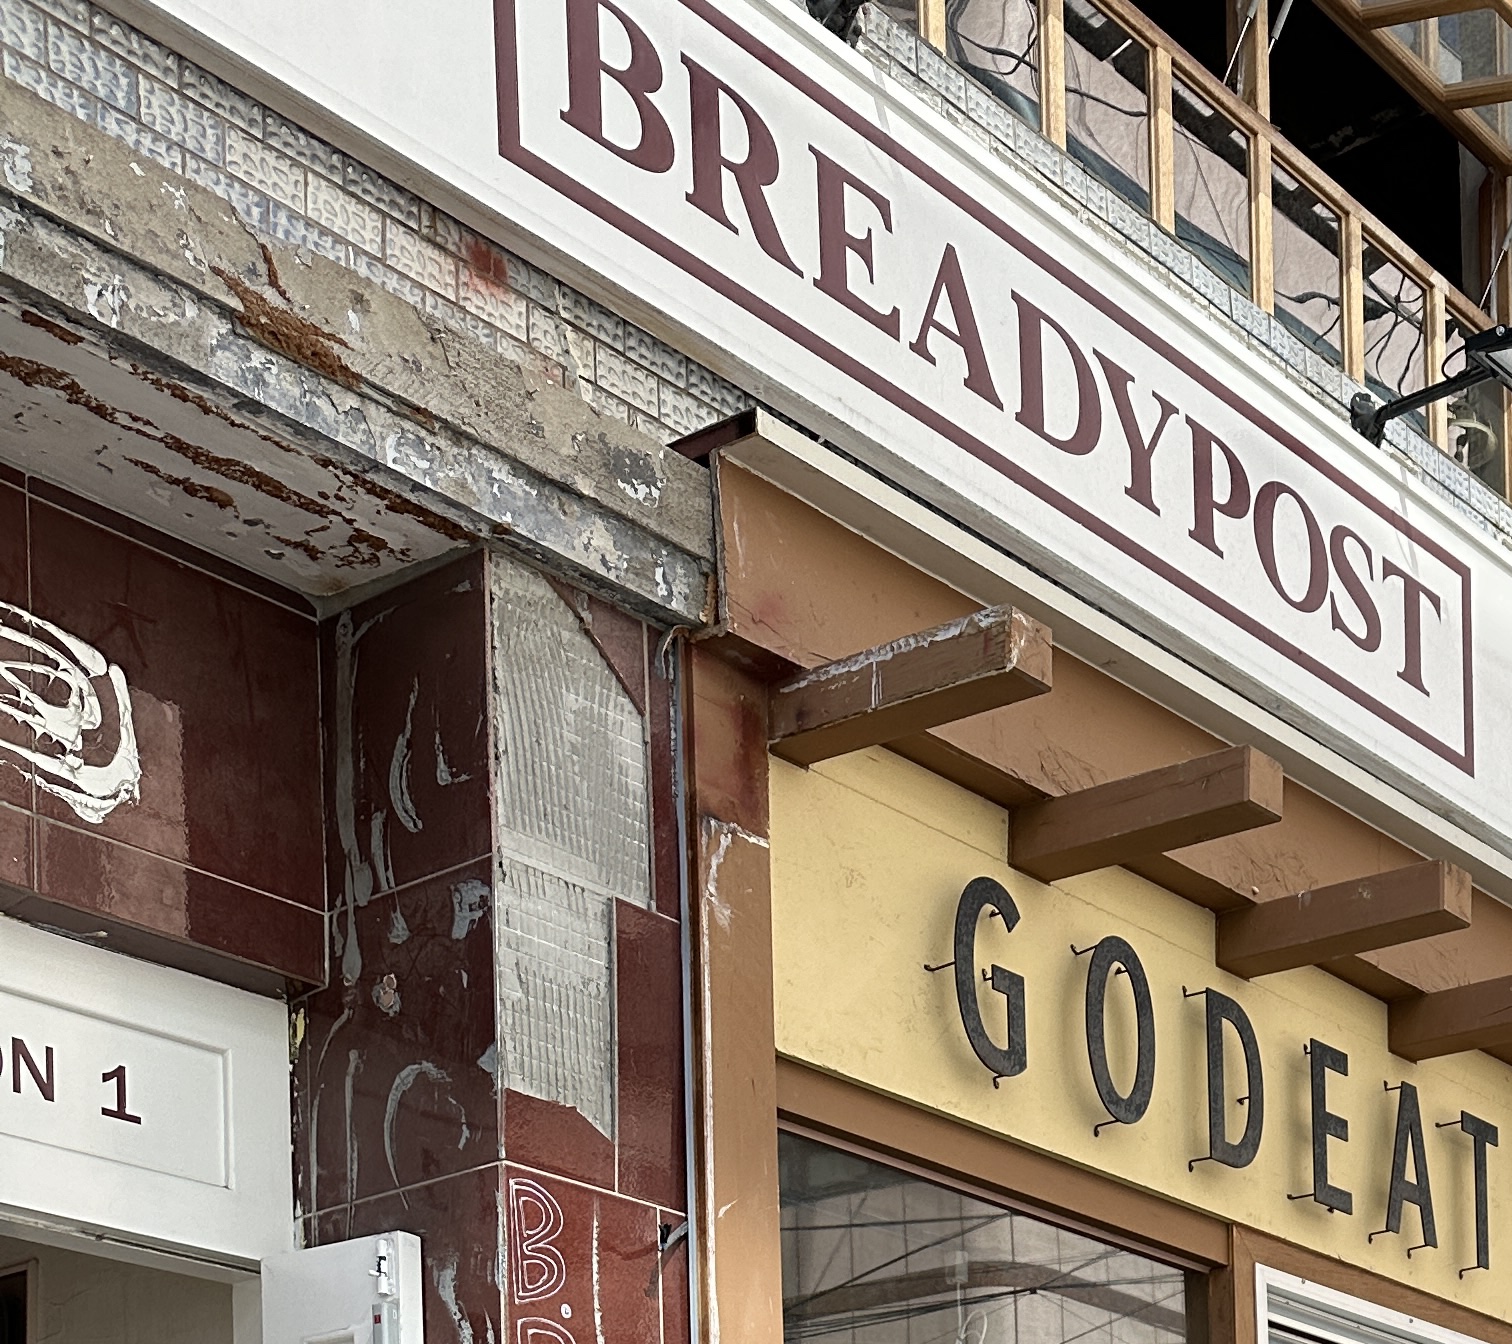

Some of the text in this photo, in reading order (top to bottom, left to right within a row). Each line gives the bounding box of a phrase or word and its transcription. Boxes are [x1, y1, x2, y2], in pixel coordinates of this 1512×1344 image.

[560, 0, 1441, 698] BREADYPOST
[0, 1035, 142, 1126] N 1
[954, 876, 1498, 1270] GODEAT
